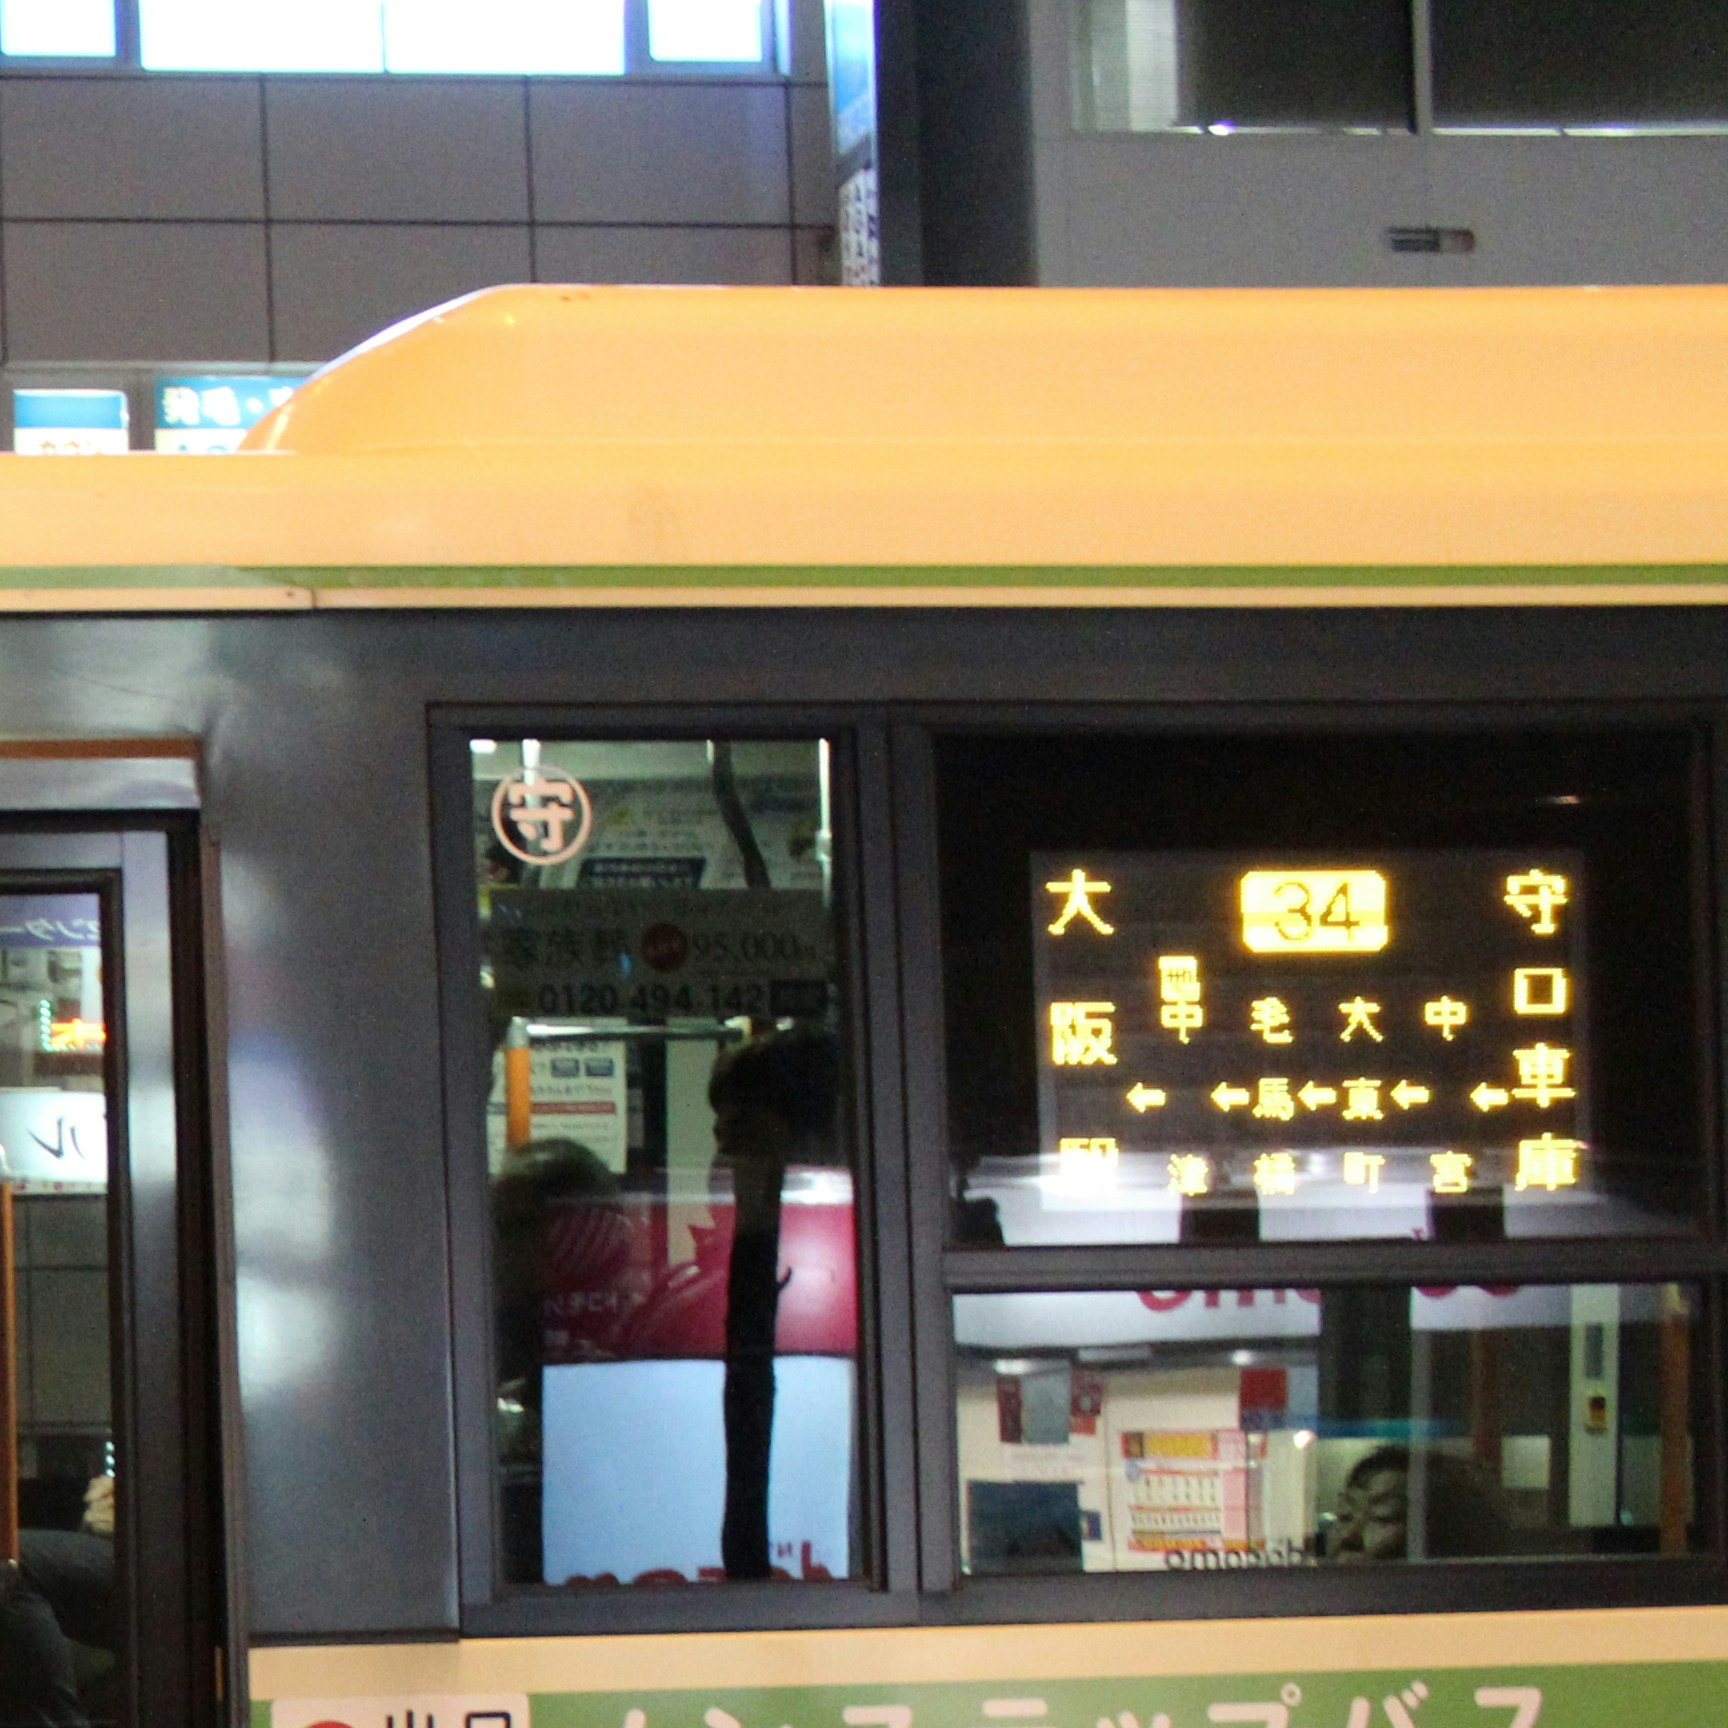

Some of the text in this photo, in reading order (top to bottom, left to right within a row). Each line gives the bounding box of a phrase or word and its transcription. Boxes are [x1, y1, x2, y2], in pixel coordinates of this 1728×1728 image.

[508, 779, 575, 853] 守
[1273, 881, 1362, 943] 34
[1044, 868, 1120, 1198] 大阪駅
[1249, 995, 1297, 1196] 毛馬橋
[1337, 995, 1388, 1196] 大東町
[1423, 994, 1473, 1194] 中宮
[1503, 868, 1578, 1193] 守口車庫
